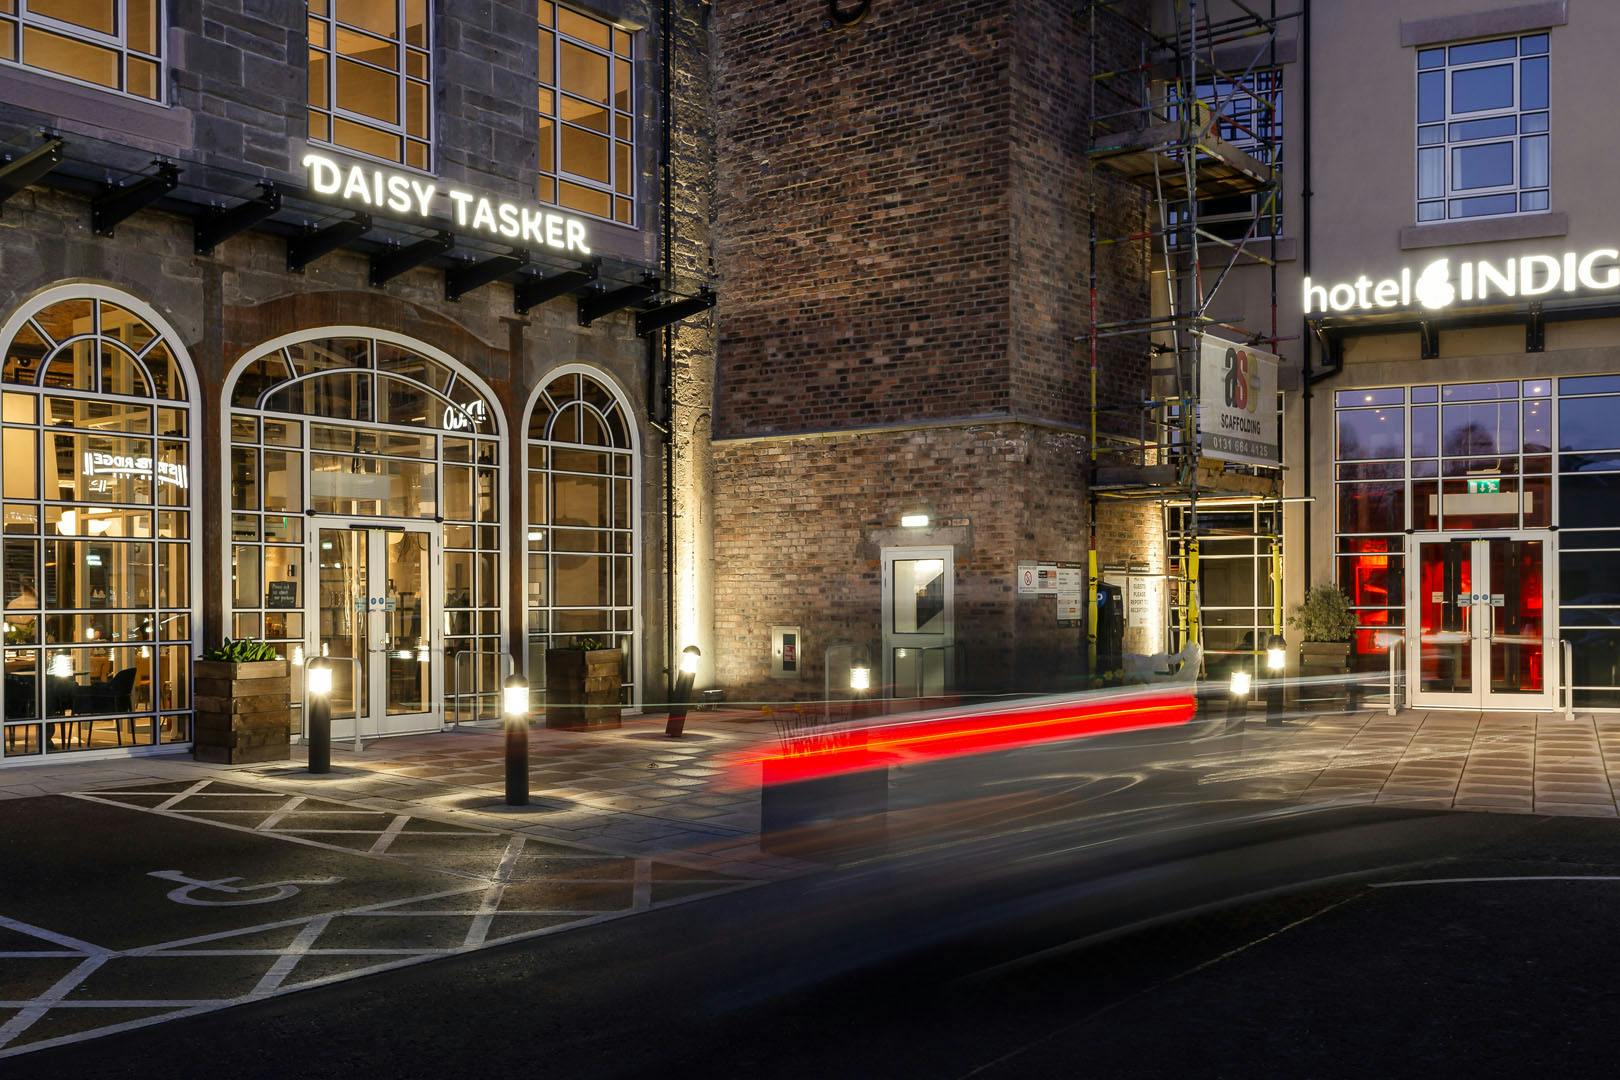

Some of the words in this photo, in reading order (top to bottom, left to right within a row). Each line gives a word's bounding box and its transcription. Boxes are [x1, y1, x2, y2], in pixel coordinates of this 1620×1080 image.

[303, 154, 436, 217] DAISY
[449, 190, 591, 254] TASKER
[1303, 267, 1411, 314] hotel
[1460, 249, 1620, 301] INDIG
[1213, 437, 1232, 450] 0131
[1221, 413, 1261, 435] SCAFFOLDING
